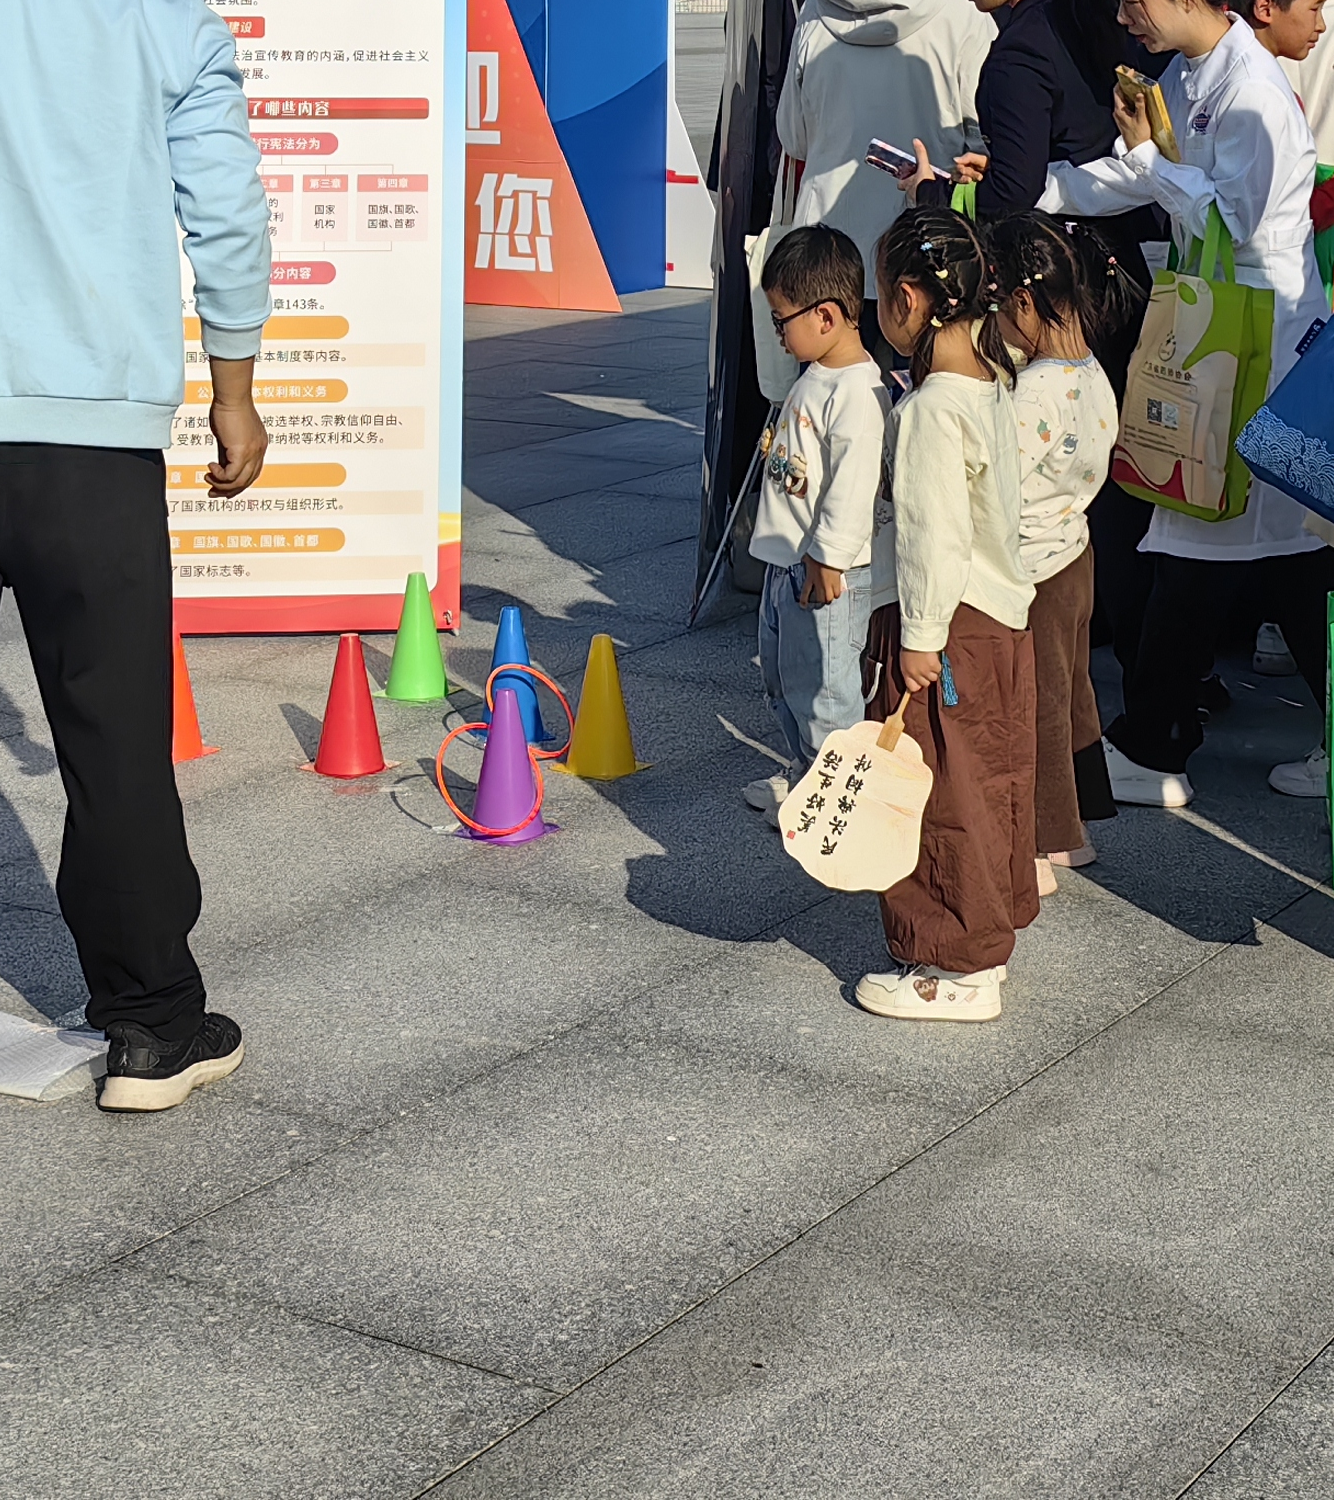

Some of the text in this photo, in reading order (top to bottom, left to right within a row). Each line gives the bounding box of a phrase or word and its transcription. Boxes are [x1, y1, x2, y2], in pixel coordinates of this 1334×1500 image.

[249, 100, 331, 117] 了哪些内容
[314, 204, 336, 215] 国家
[314, 218, 336, 229] 机构
[269, 266, 312, 280] 分内容
[797, 749, 843, 833] 美好生活
[820, 753, 873, 856] 民法典相伴
